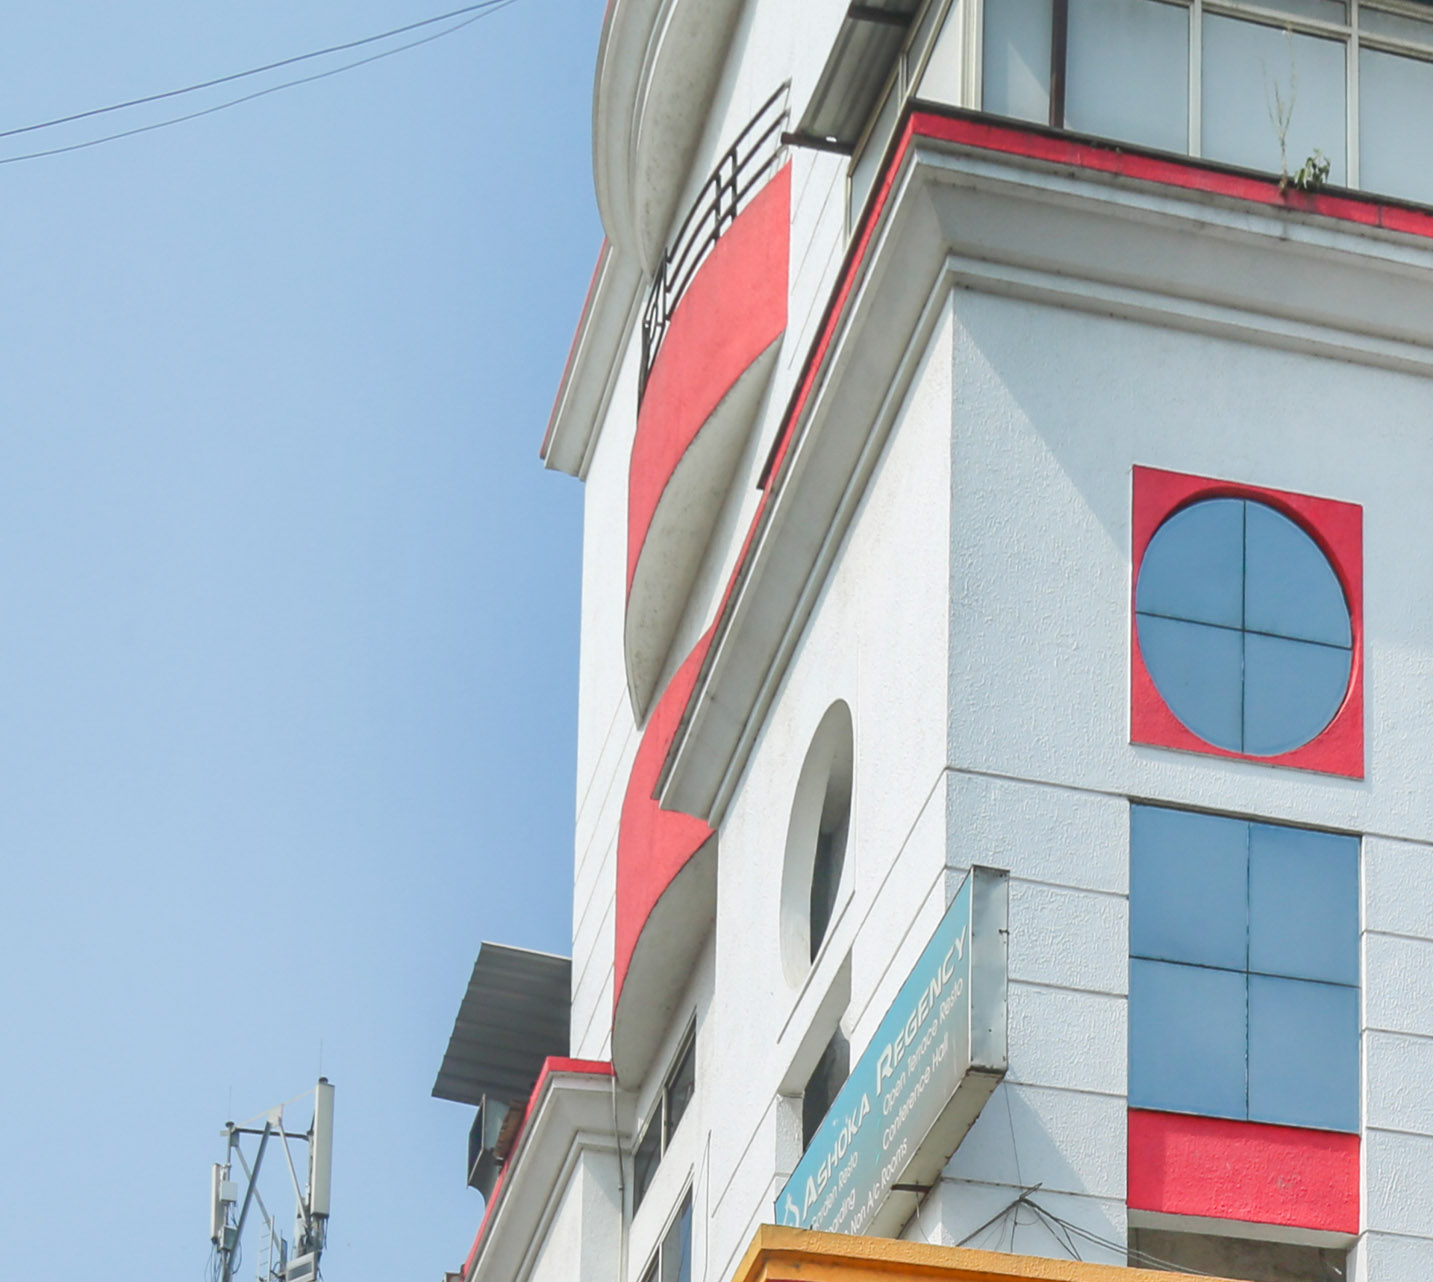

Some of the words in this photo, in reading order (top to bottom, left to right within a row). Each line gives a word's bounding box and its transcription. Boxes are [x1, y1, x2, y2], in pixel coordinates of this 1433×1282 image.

[803, 1093, 871, 1221] ASHOKA
[876, 924, 967, 1096] REGENCY
[883, 1073, 906, 1115] Open
[908, 1019, 938, 1077] Terrace
[940, 978, 963, 1025] Resto
[883, 1068, 930, 1150] Conference
[933, 1032, 949, 1072] Hall
[881, 1138, 907, 1190] Rooms
